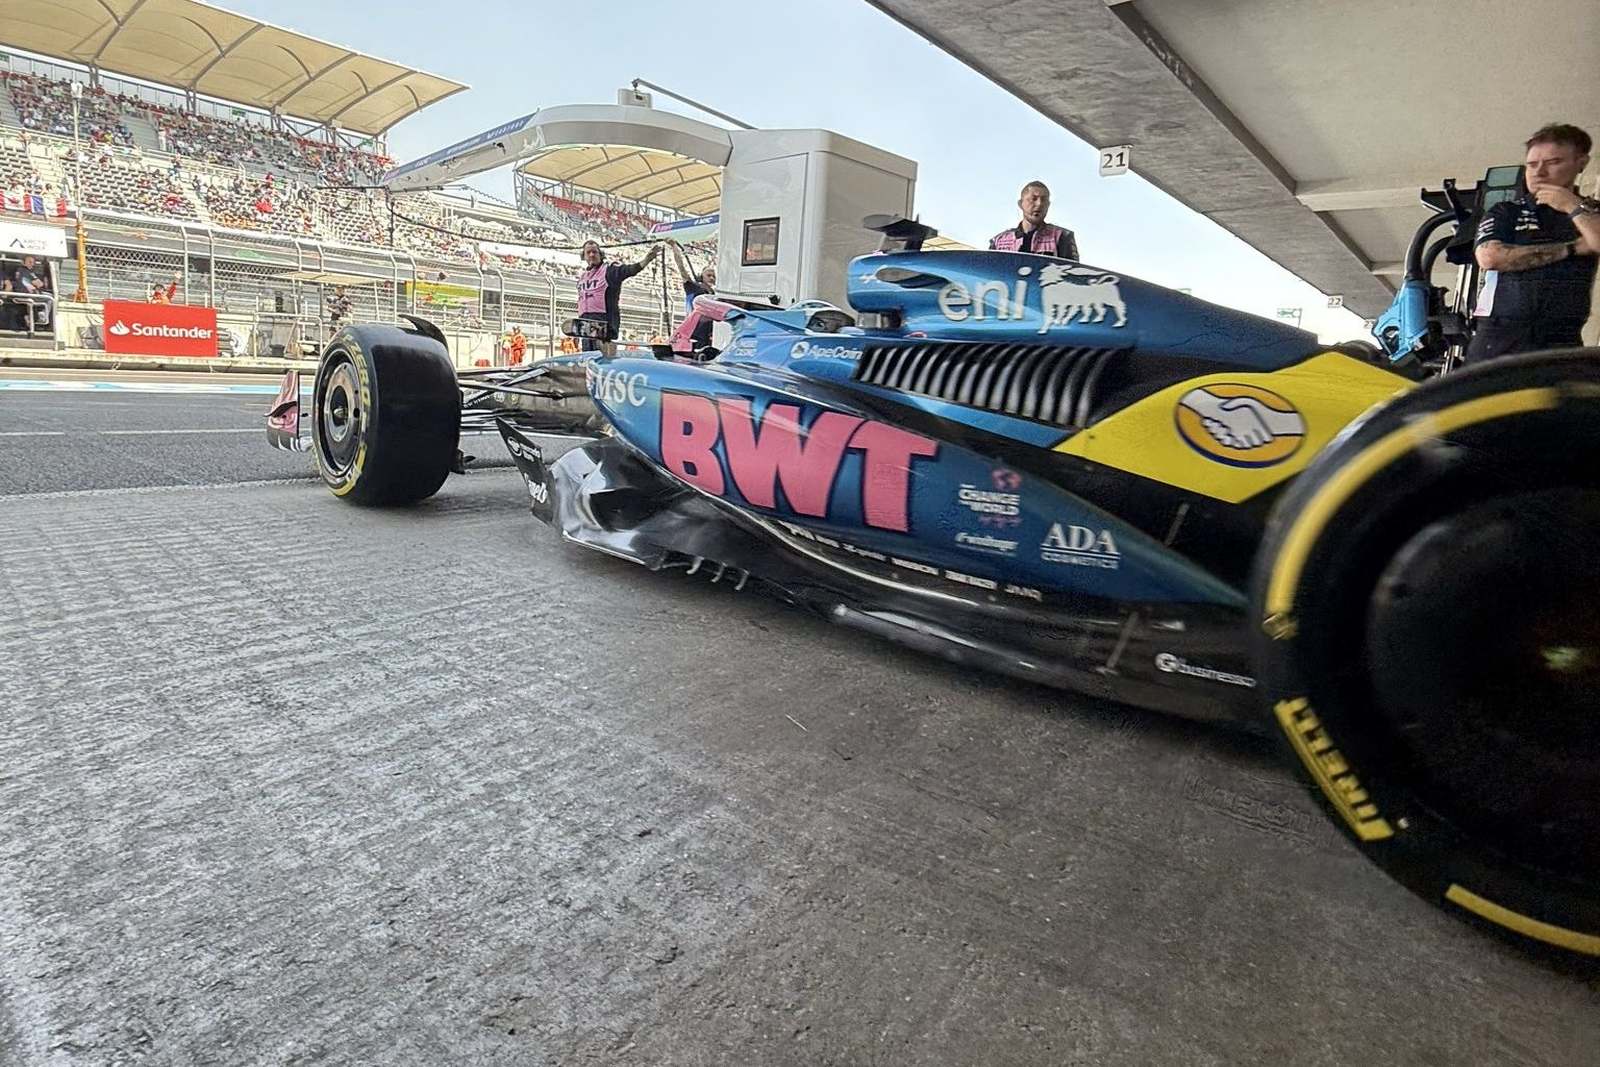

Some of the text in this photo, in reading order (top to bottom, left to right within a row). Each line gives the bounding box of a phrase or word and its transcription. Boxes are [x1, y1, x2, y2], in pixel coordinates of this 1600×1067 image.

[1103, 152, 1126, 169] 21
[938, 266, 1032, 322] eni
[132, 322, 213, 339] Santander
[809, 344, 864, 360] ApeCoin
[594, 367, 649, 407] MSC
[661, 389, 938, 533] BWT
[1040, 522, 1121, 556] ADA
[1272, 697, 1395, 842] PIRELLI
